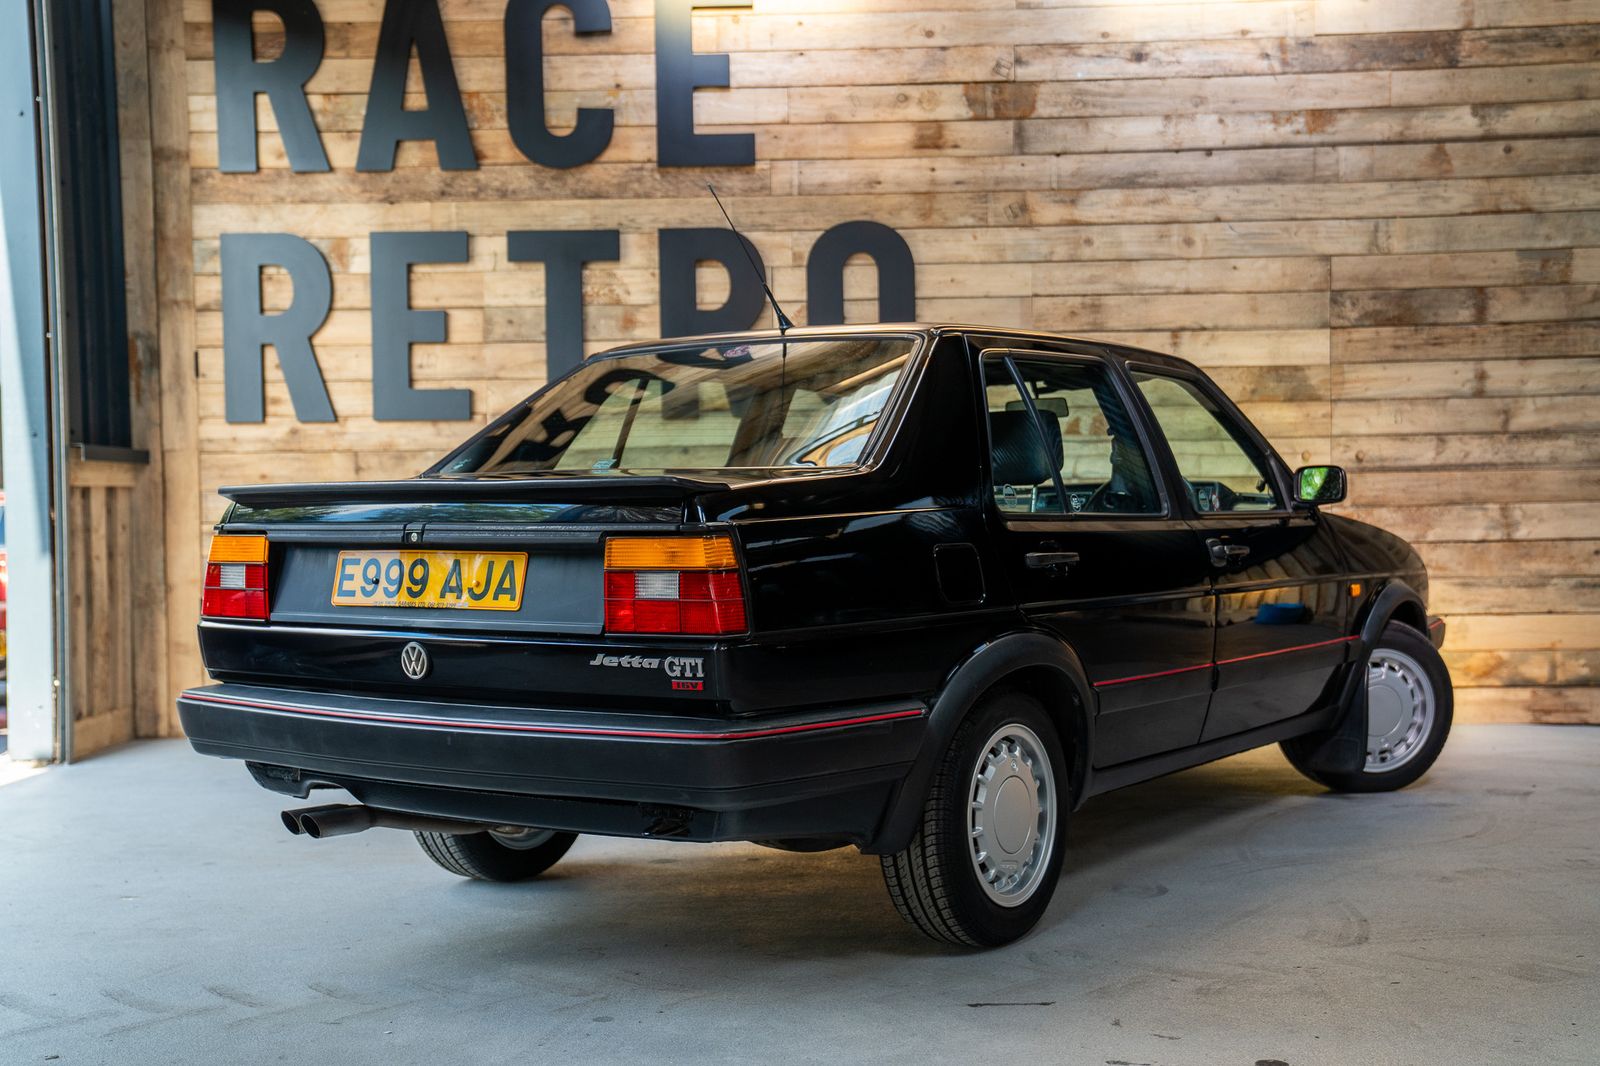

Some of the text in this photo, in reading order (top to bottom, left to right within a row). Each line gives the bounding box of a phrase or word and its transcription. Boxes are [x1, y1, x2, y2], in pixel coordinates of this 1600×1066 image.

[212, 0, 756, 174] RACE
[336, 557, 518, 602] E999 AJA
[401, 642, 428, 680] VW
[589, 653, 705, 678] Jetta GTI
